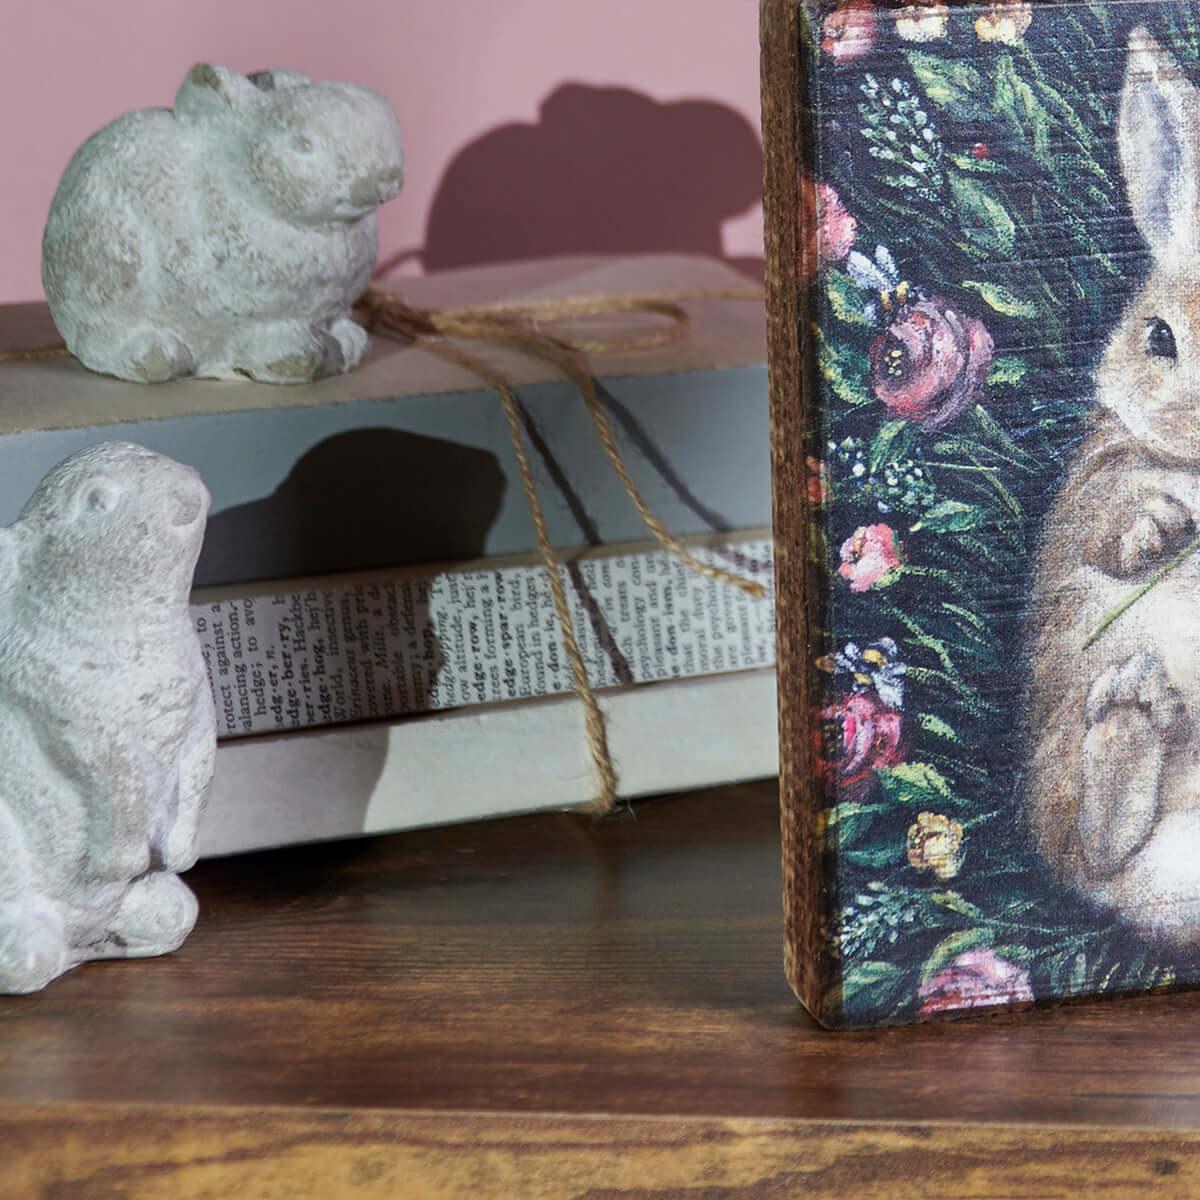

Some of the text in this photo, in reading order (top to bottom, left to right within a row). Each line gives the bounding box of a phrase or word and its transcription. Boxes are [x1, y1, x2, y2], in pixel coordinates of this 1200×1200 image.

[524, 577, 539, 628] hedges
[617, 582, 630, 623] treats
[645, 581, 658, 609] and
[692, 588, 705, 622] duty
[450, 609, 468, 673] altitude,
[531, 632, 542, 647] in
[633, 596, 654, 680] psychology
[679, 609, 691, 633] the
[213, 622, 230, 675] against
[247, 636, 259, 653] to
[514, 624, 532, 696] European
[651, 617, 668, 678] pleasant
[683, 644, 695, 674] that
[695, 629, 709, 671] moral
[713, 647, 724, 670] the
[220, 685, 237, 731] rotect
[234, 664, 252, 730] alancing
[250, 662, 267, 716] hedge;
